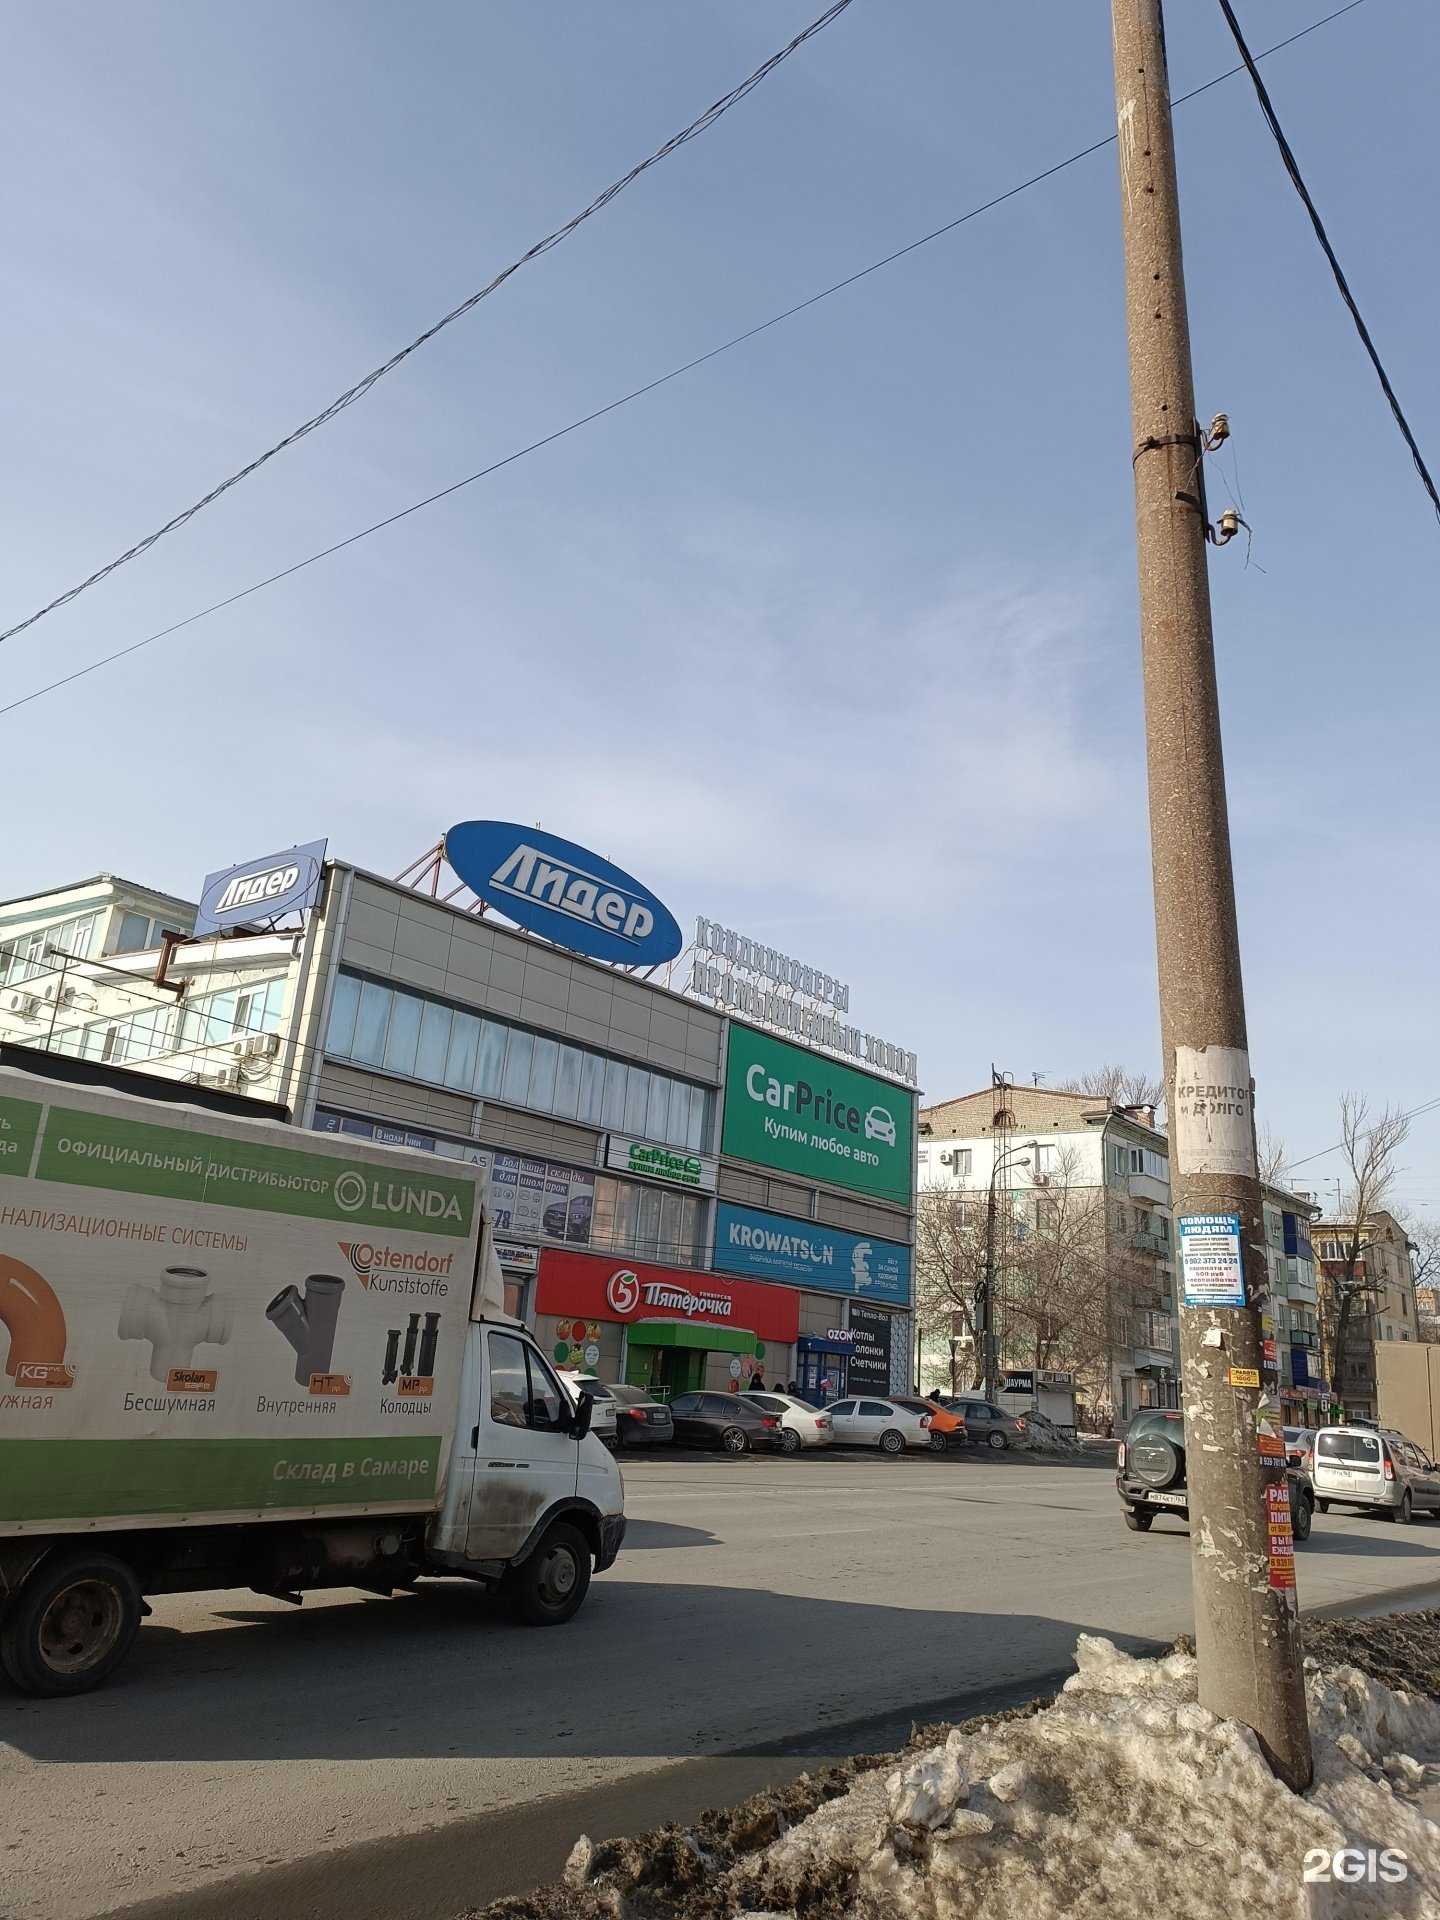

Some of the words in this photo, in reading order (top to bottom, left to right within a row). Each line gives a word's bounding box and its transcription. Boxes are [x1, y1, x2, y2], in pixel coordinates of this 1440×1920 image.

[215, 864, 299, 912] Лидер
[490, 844, 655, 942] Лидер
[695, 915, 849, 1013] КОНДИЦИОНЕРЫ
[692, 961, 861, 1058] ПРОМЫШЛЕННЫЙ
[864, 1033, 918, 1086] ХОЛОД
[746, 1064, 860, 1134] CarPrice
[764, 1116, 808, 1145] Купим
[809, 1134, 851, 1157] любое
[853, 1149, 880, 1167] авто
[57, 1137, 203, 1175] ОФИЦИАЛЬНЫЙ
[206, 1162, 329, 1194] ДИСТРИБЬЮТОР
[629, 1143, 684, 1170] CarPrice
[371, 1181, 463, 1222] LUNDA
[1, 1206, 168, 1242] НАЛИЗАЦИОННЫЕ
[171, 1227, 248, 1252] СИСТЕМЫ
[1180, 1216, 1236, 1226] ПОМОЩЬ
[1184, 1225, 1233, 1235] ЛЮДЯМ
[729, 1222, 833, 1265] KROWATSON
[357, 1243, 454, 1274] Ostendorf
[369, 1274, 449, 1297] Kunststoffe
[827, 1328, 853, 1341] OZON
[851, 1328, 875, 1342] Котлы
[854, 1344, 884, 1356] олонки
[20, 1366, 49, 1380] KG
[850, 1356, 887, 1371] Счетчики
[172, 1371, 206, 1383] Skolan
[401, 1379, 420, 1391] MP
[1004, 1378, 1032, 1388] ШАУРМА
[124, 1392, 216, 1415] Бесшумная
[256, 1396, 337, 1416] Внутренняя
[380, 1397, 432, 1415] Колодцы
[273, 1459, 336, 1483] Склад
[342, 1461, 354, 1478] в
[360, 1457, 429, 1481] Самаре
